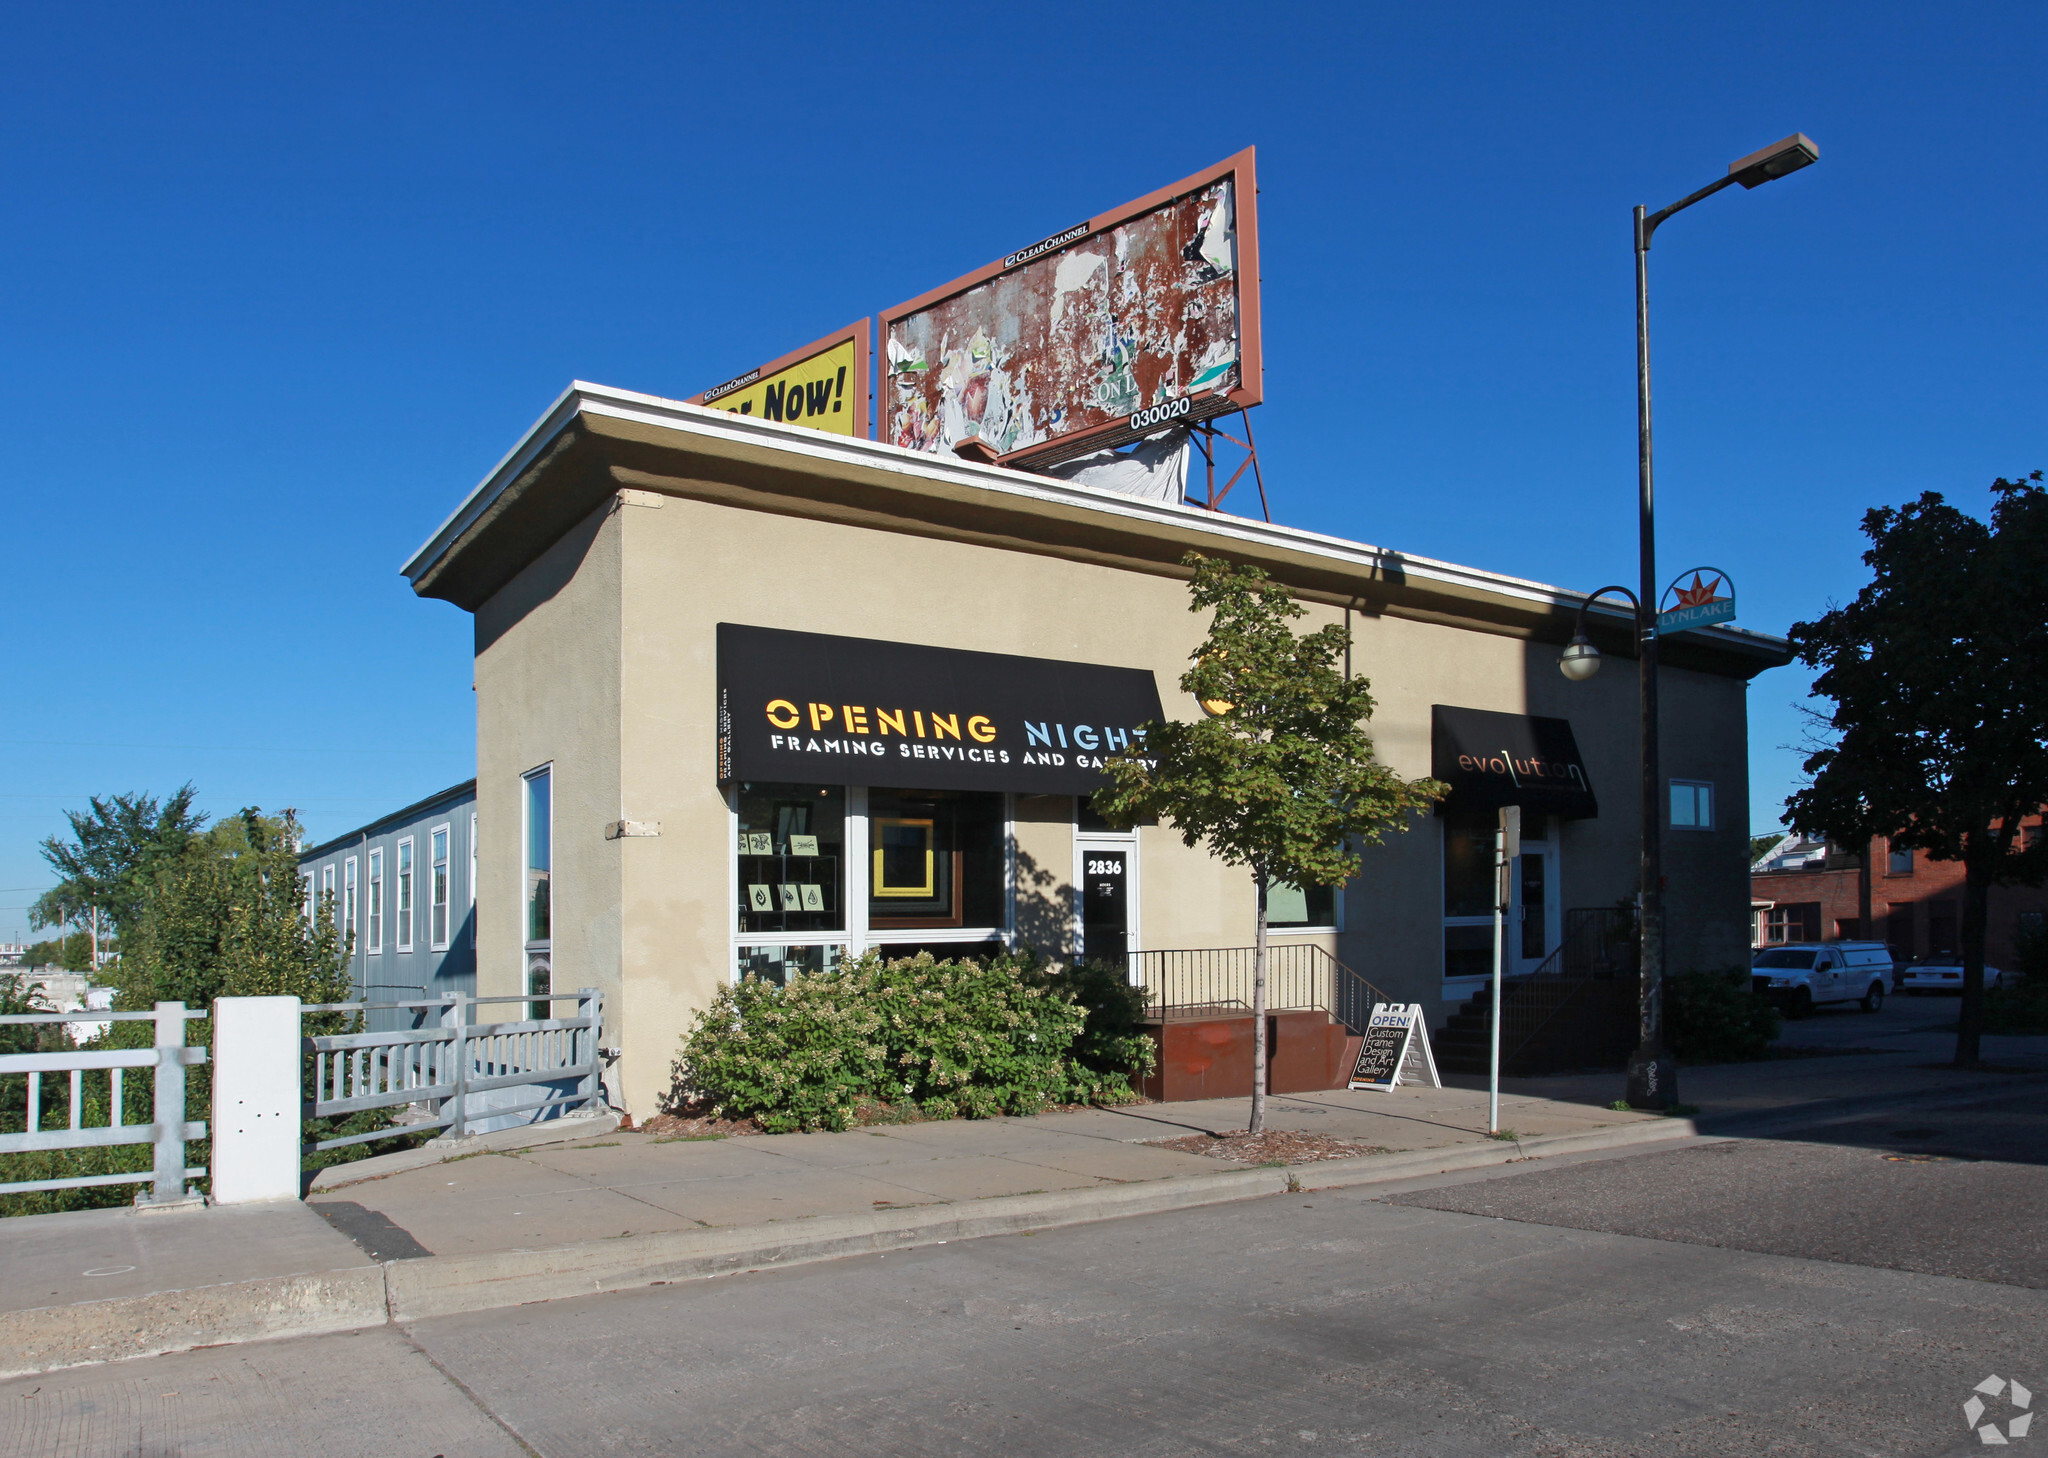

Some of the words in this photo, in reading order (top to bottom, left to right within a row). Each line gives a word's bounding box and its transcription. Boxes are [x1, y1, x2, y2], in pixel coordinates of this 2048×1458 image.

[1130, 397, 1190, 430] 030020
[1661, 600, 1733, 627] LYNLAKE
[766, 699, 996, 743] OPENING
[771, 735, 886, 756] FRAMING
[900, 743, 1010, 764] SERVICES
[1023, 751, 1065, 766] AND
[1088, 860, 1122, 875] 2836
[1372, 1015, 1411, 1027] OPEN!
[1369, 1027, 1404, 1038] Custom
[1366, 1036, 1394, 1048] Frame
[1363, 1045, 1393, 1058] Design
[1360, 1055, 1377, 1065] and
[1377, 1055, 1394, 1066] Art
[1357, 1063, 1389, 1077] Gallery
